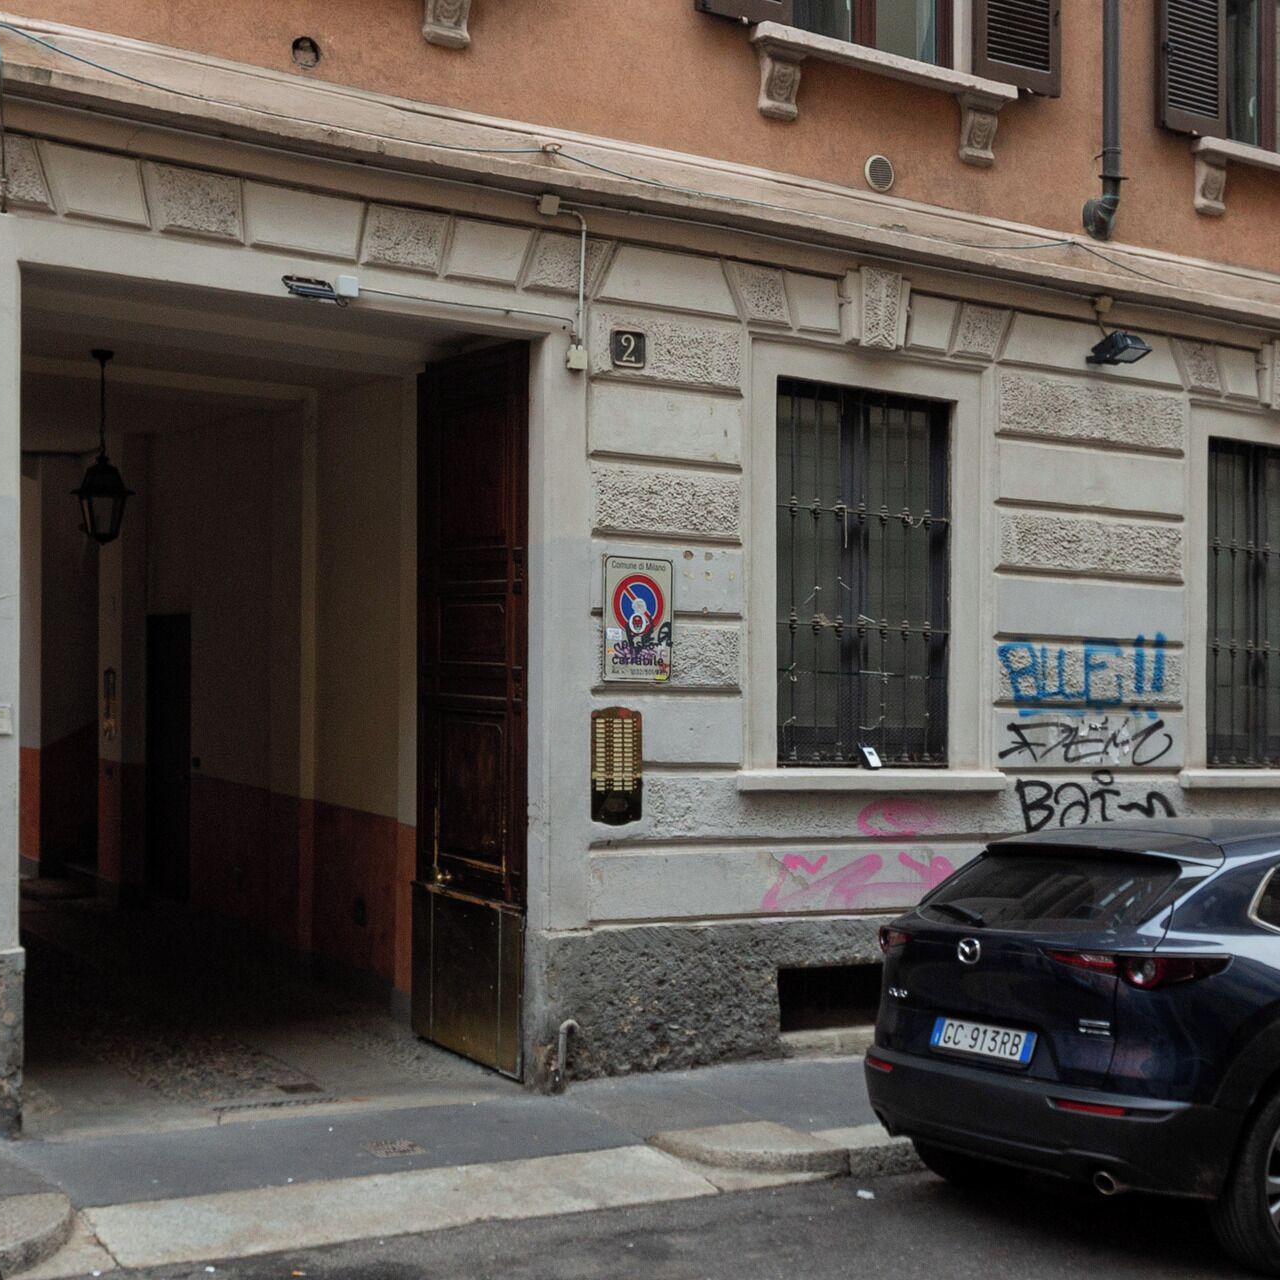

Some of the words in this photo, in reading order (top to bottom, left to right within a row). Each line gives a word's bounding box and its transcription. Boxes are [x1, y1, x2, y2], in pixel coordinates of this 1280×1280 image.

[621, 334, 636, 362] 2
[611, 560, 637, 570] Comune
[639, 562, 644, 570] di
[646, 563, 667, 572] Milano
[942, 1022, 965, 1046] GC
[968, 1027, 1022, 1057] 913RB
